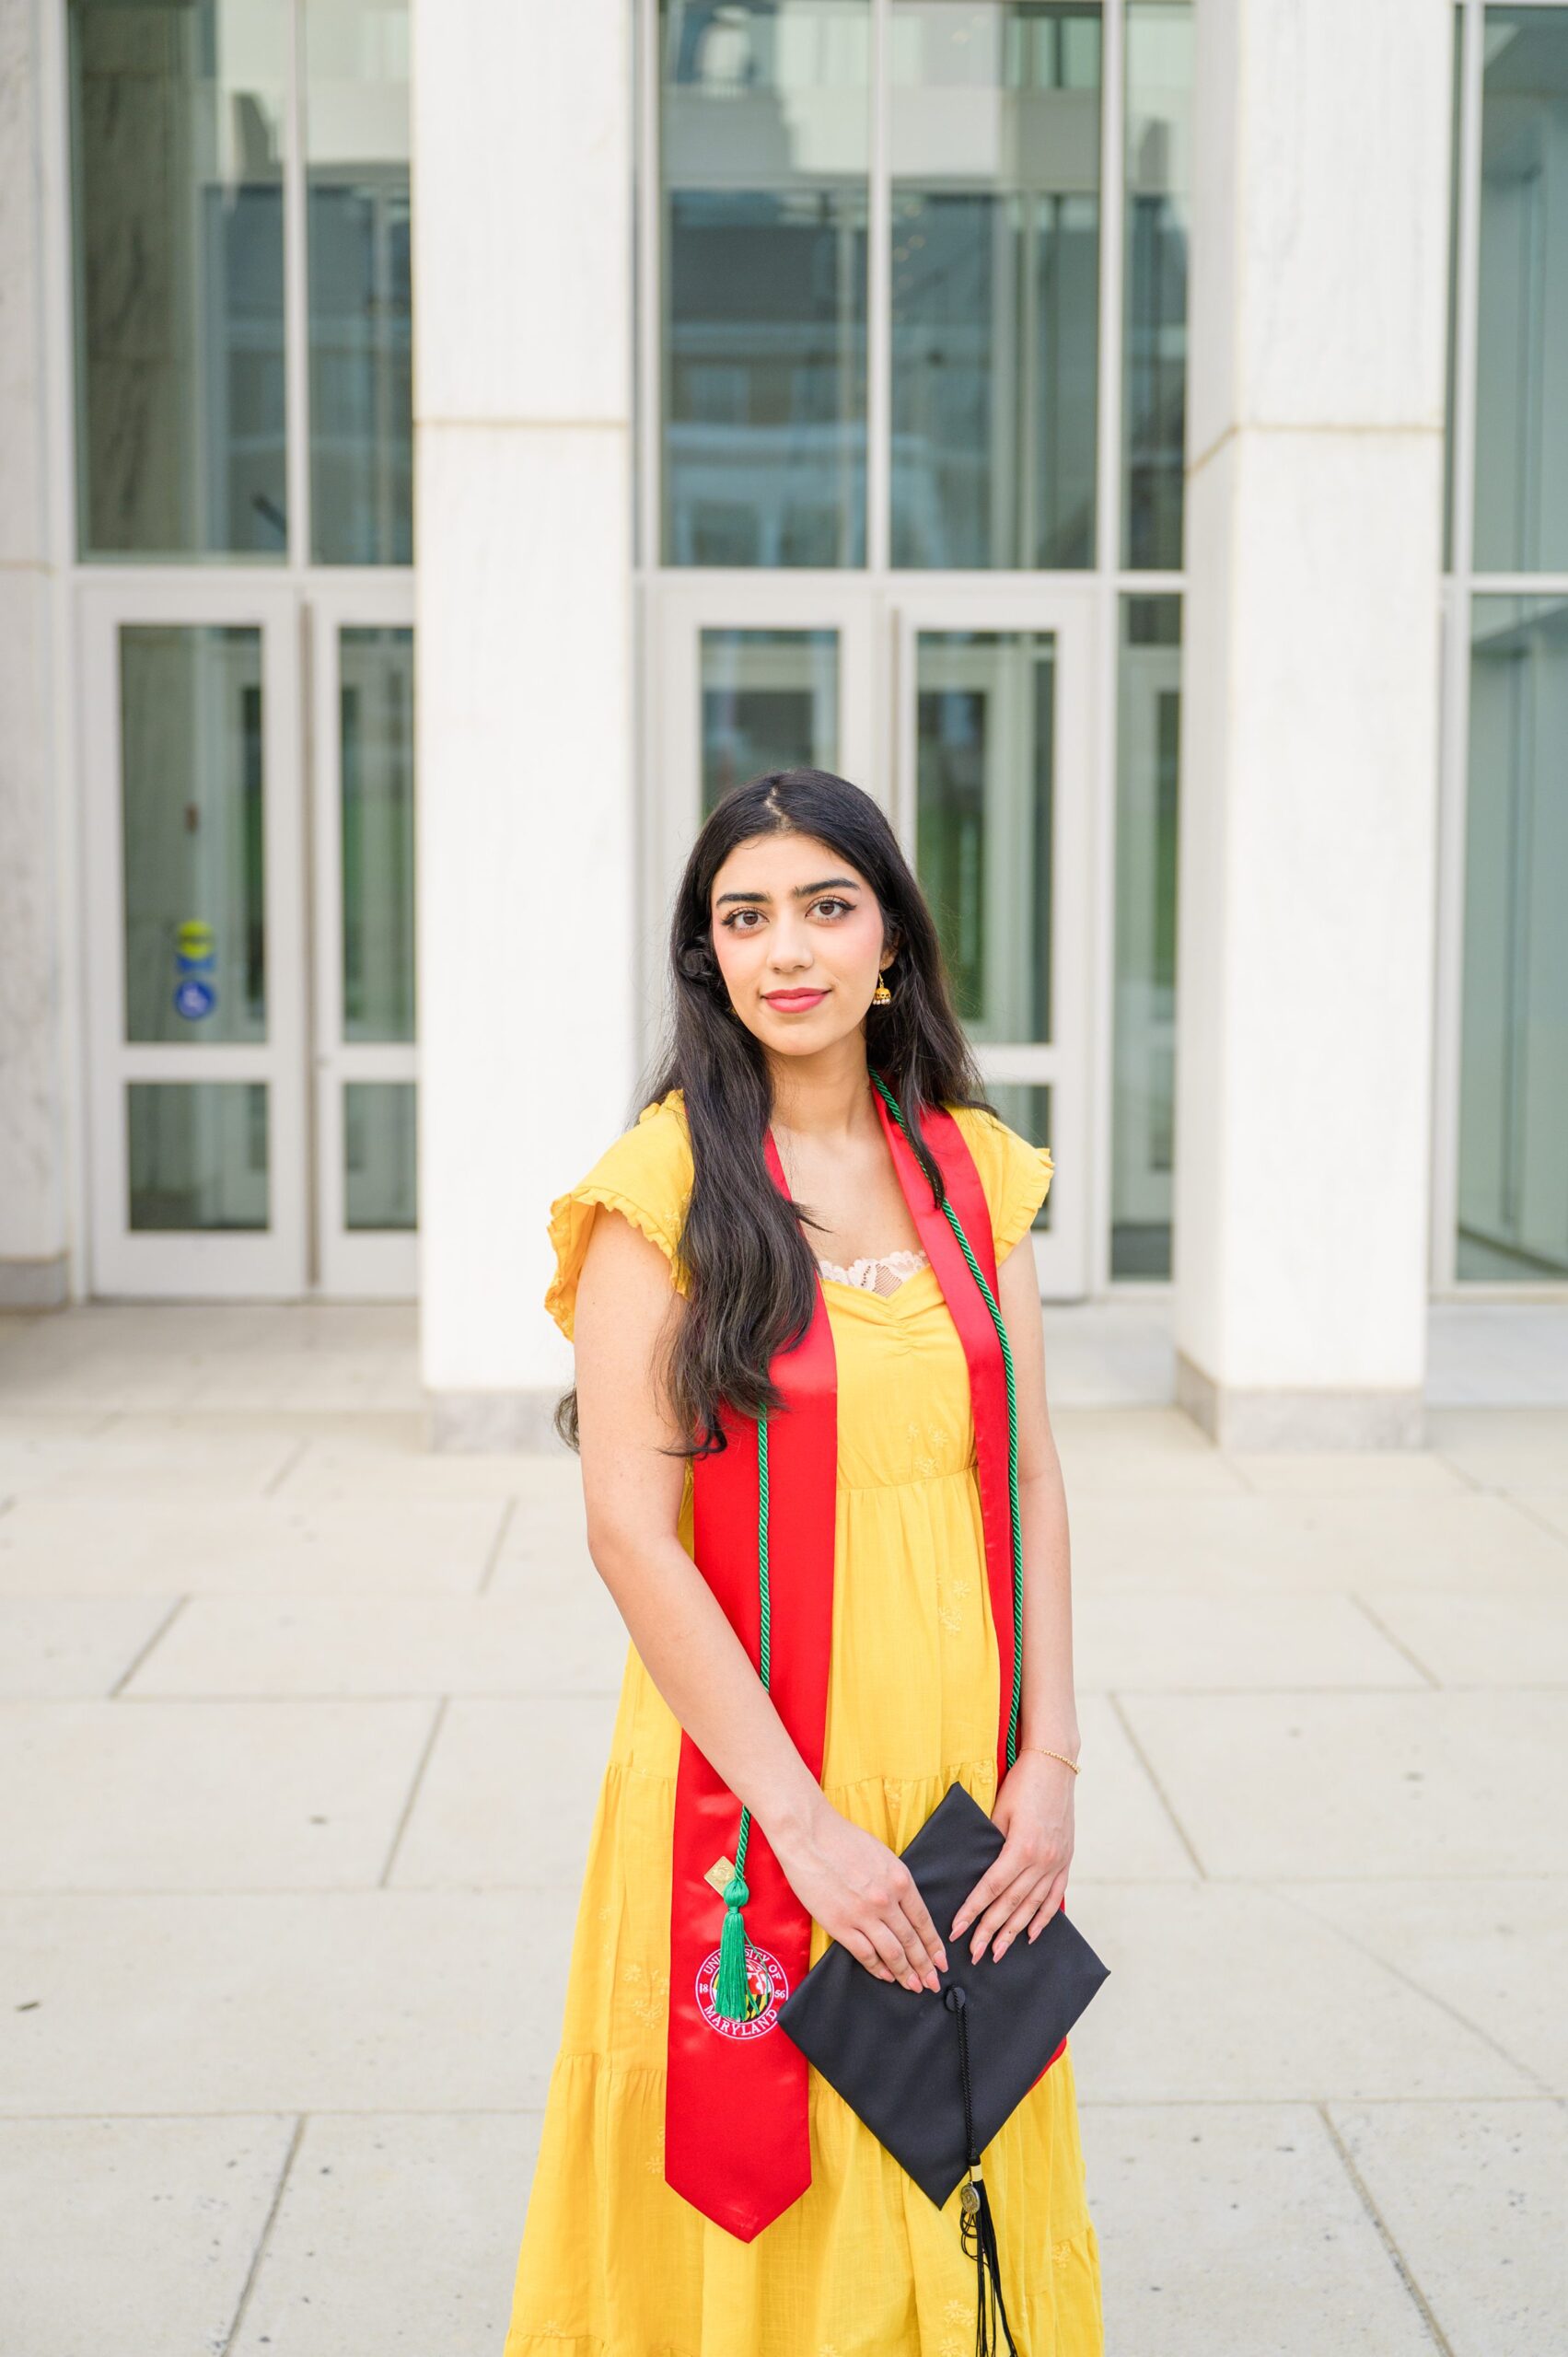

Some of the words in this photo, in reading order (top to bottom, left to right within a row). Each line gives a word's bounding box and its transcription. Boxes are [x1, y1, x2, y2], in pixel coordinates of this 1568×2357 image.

[768, 1964, 783, 1980] OF
[699, 1983, 709, 1993] 18
[774, 1990, 785, 1999] 56
[704, 2004, 778, 2036] MARYLAND
